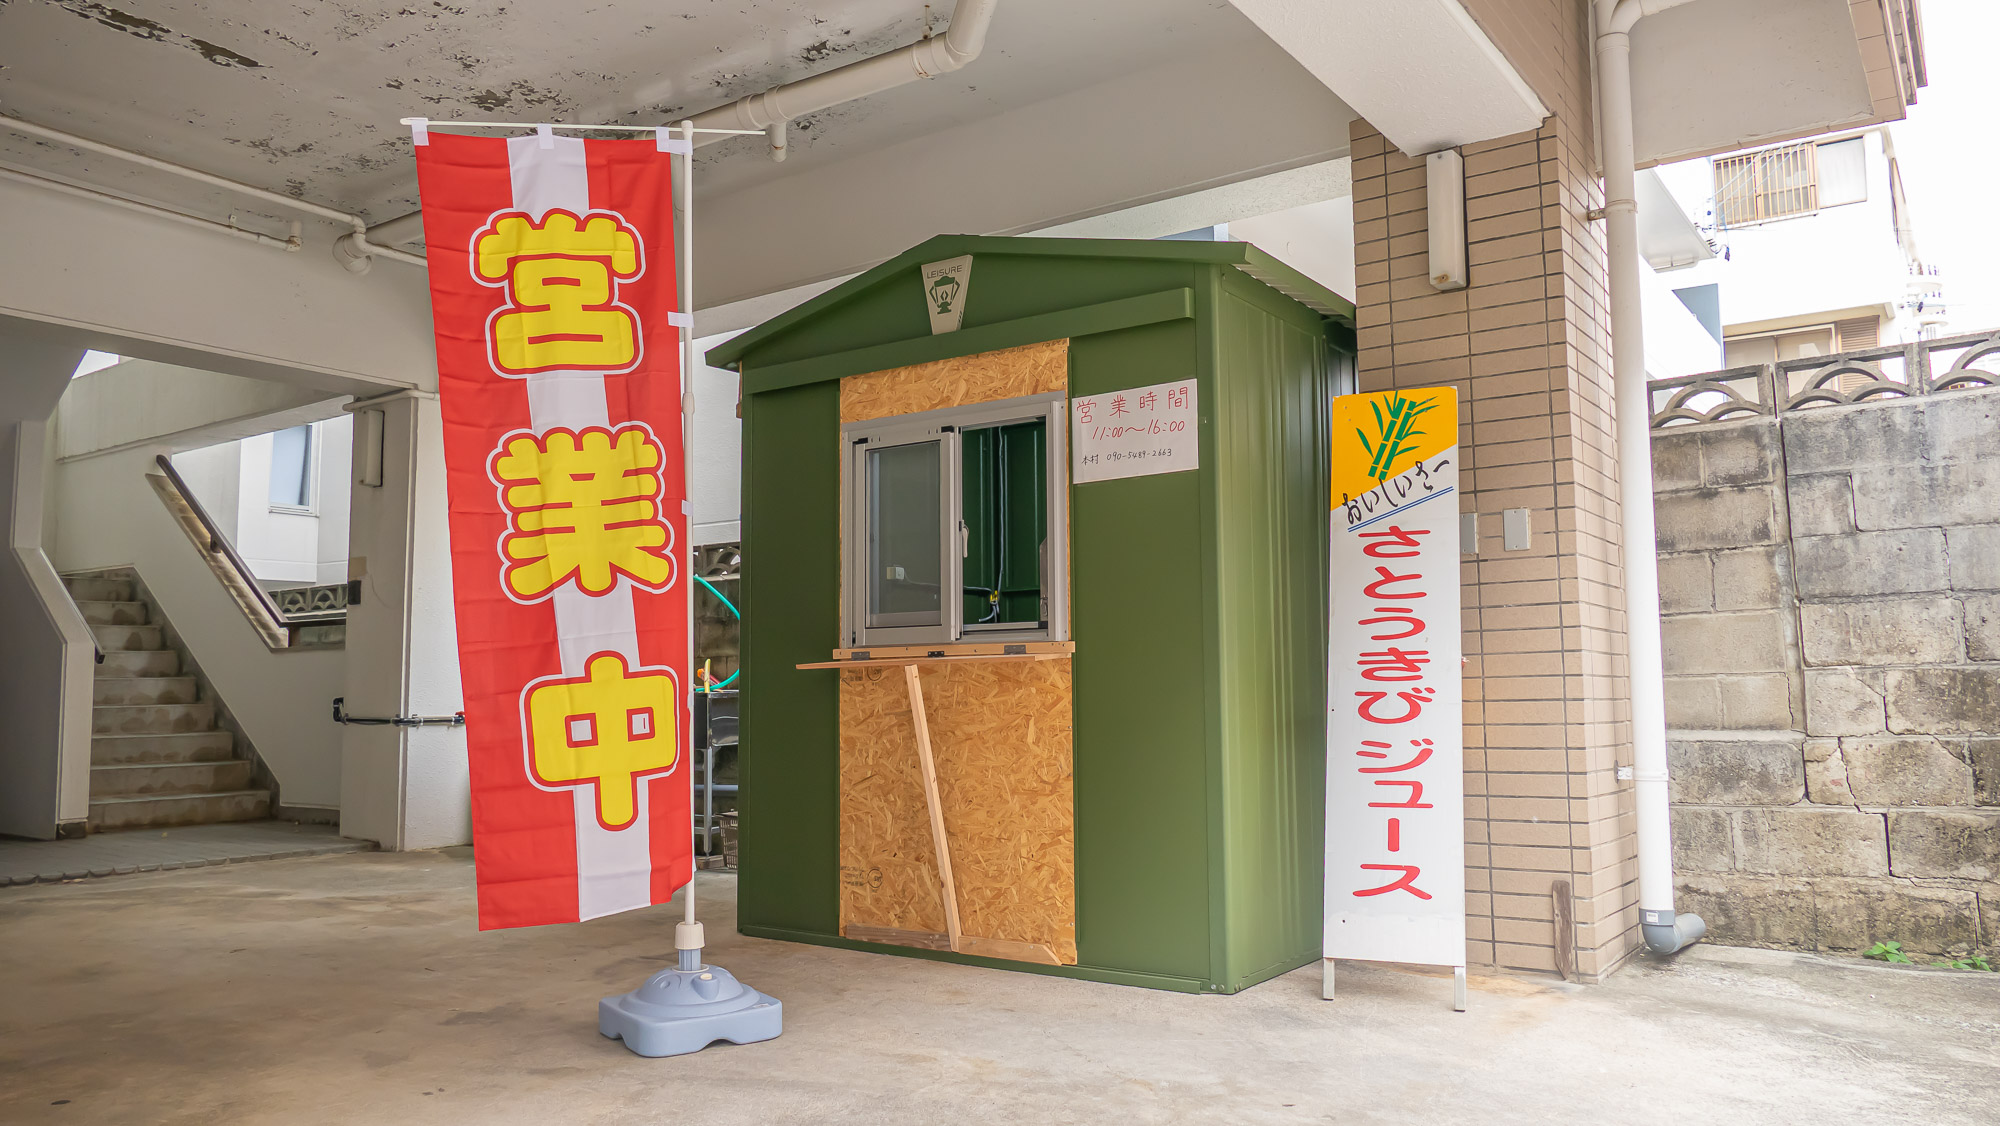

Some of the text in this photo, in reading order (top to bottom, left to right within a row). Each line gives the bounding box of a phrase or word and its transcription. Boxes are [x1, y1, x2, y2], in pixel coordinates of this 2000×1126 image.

[926, 264, 963, 279] LEISURE
[1076, 386, 1189, 424] 営業時間
[1106, 448, 1172, 461] 090-5489-2663
[472, 209, 680, 830] 営業中
[1352, 525, 1436, 901] さとうきびジュース
